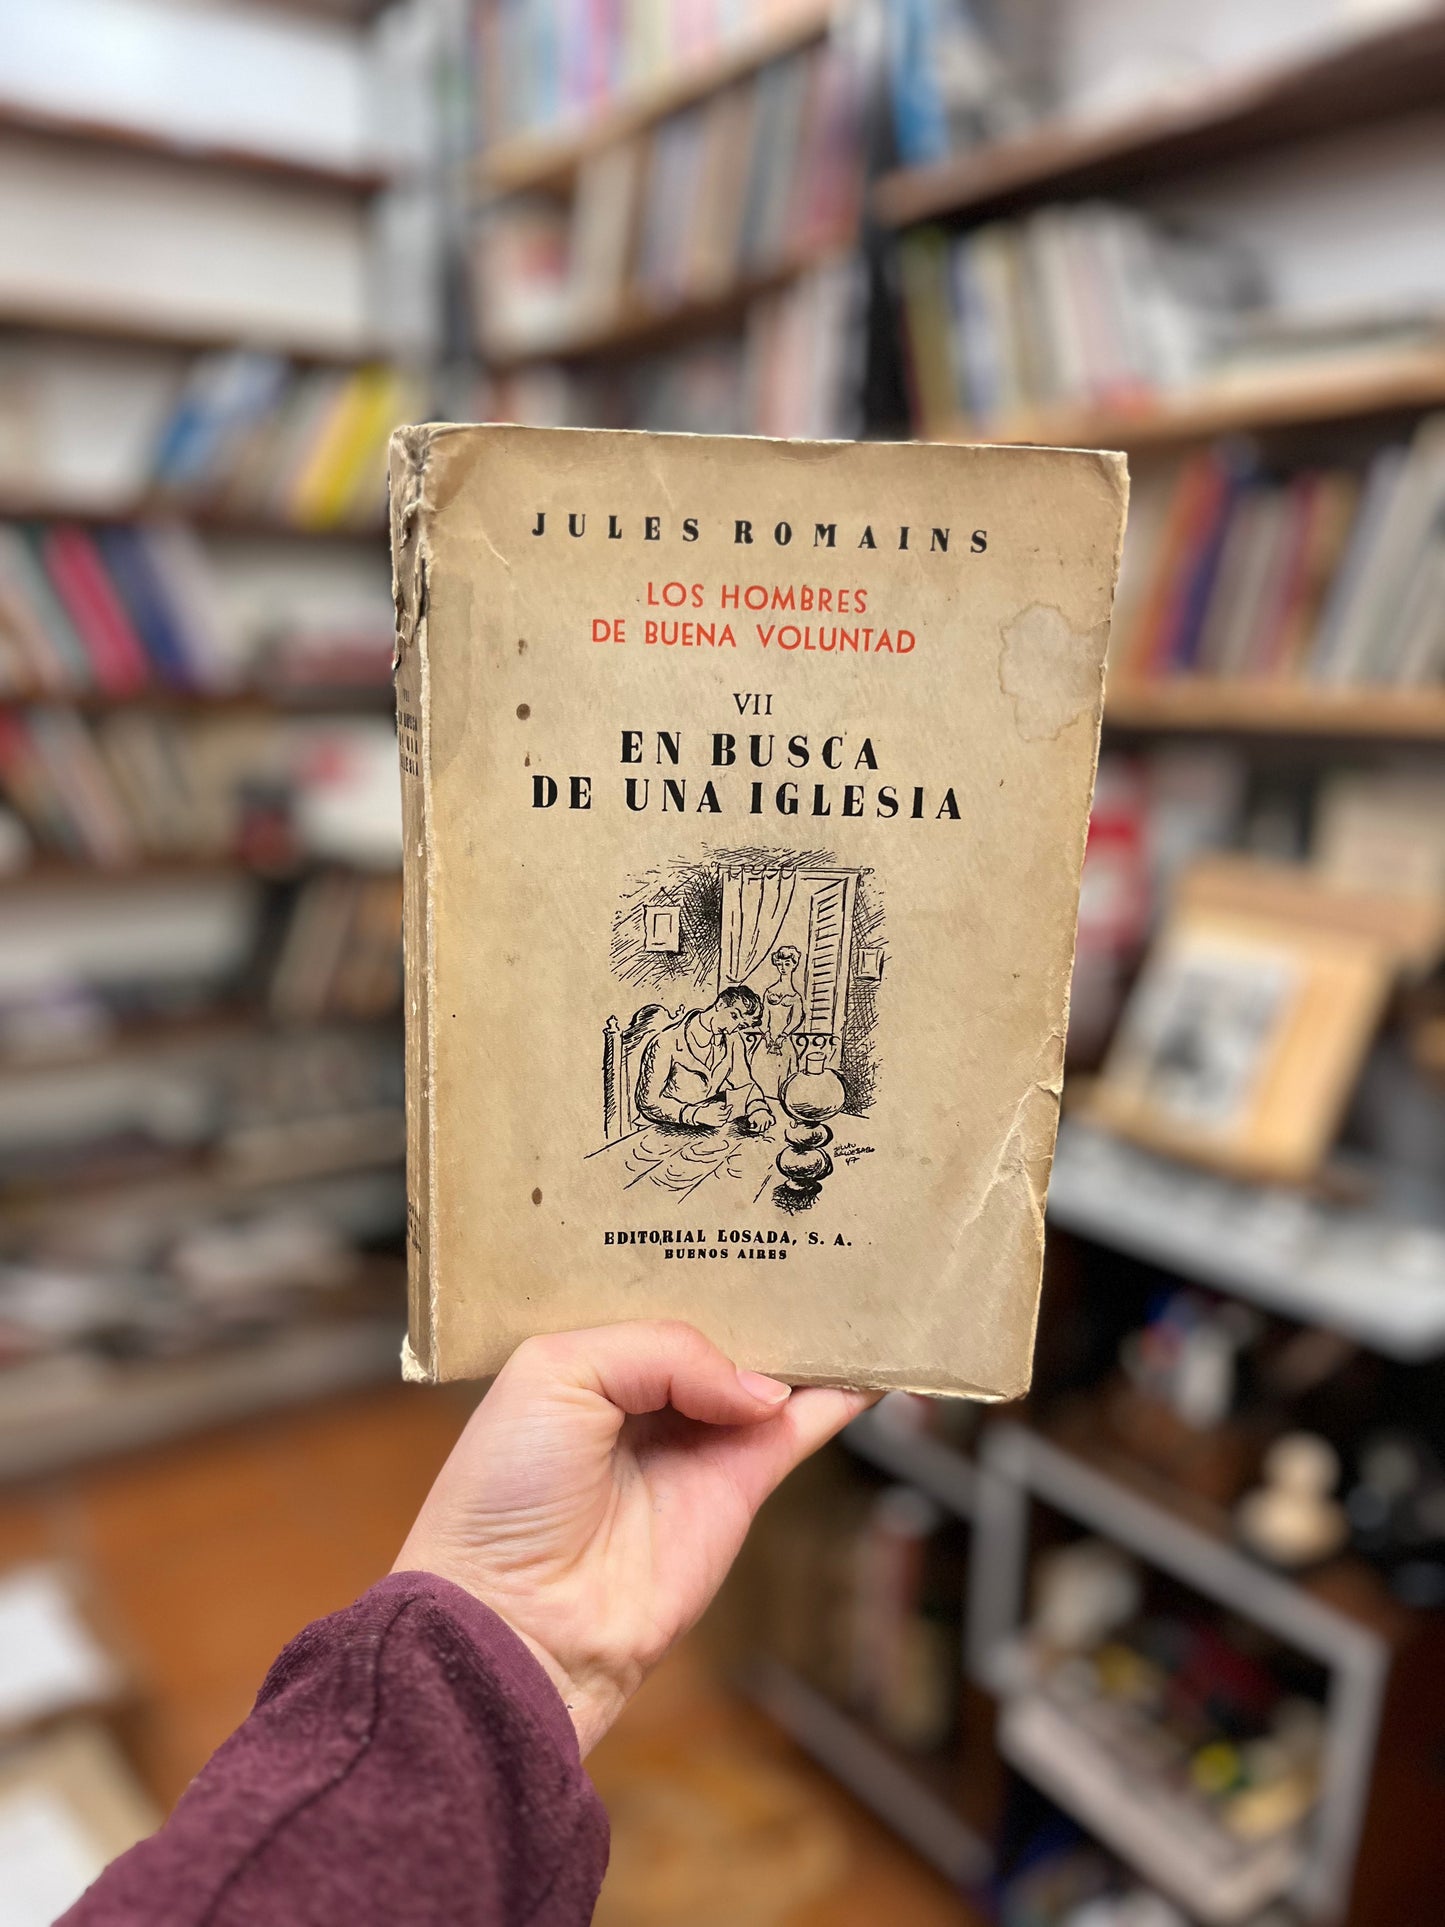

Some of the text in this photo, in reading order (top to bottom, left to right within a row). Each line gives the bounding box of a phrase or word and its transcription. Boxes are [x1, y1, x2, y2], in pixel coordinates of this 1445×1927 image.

[531, 512, 987, 554] JULES ROMAINS
[647, 582, 867, 614] LOS HOMBRES
[592, 619, 915, 654] DE BUENA VOLUNTAD
[732, 693, 773, 716] VII
[620, 730, 879, 770] EN BUSCA
[531, 774, 962, 820] DE UNA IGLESIA
[604, 1229, 852, 1247] EDITORIAL LOSADA, S. A.
[664, 1248, 787, 1260] BUENOS AIRES
